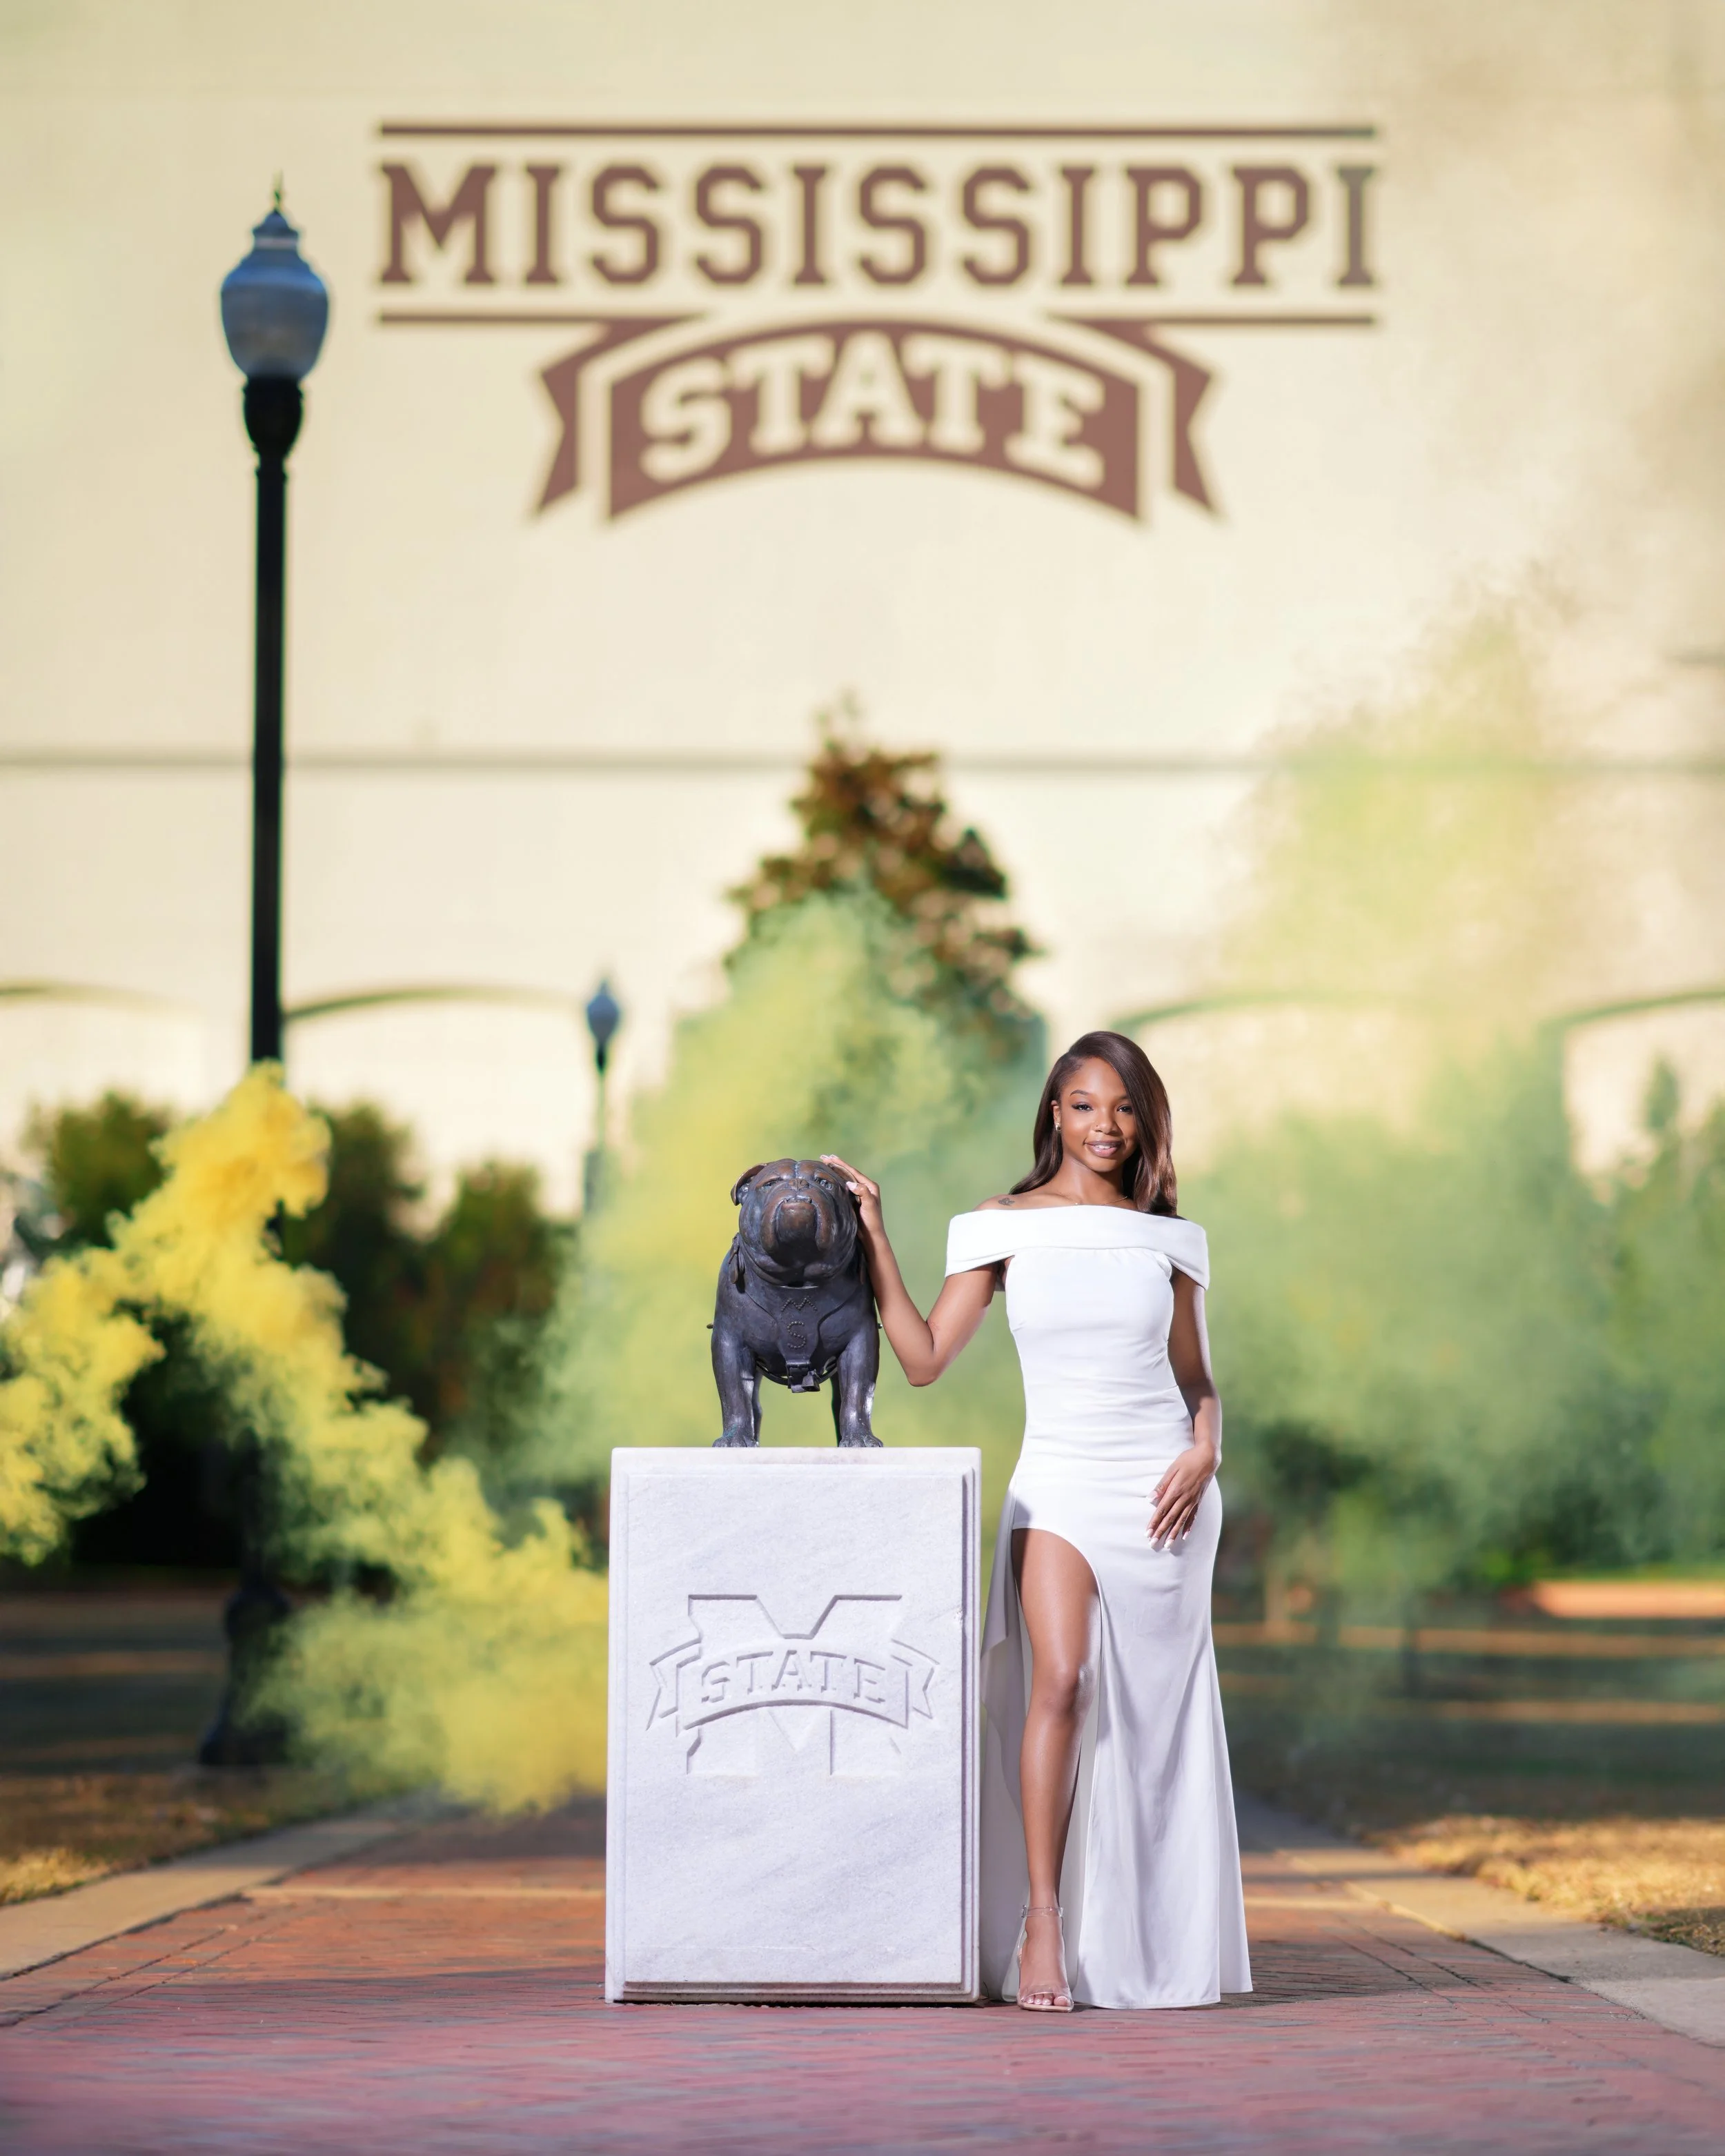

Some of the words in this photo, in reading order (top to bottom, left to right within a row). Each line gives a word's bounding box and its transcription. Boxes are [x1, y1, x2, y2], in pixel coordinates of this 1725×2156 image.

[379, 162, 1377, 287] MISSISSIPPI
[638, 330, 1107, 490] STATE
[700, 1649, 887, 1705] STATE
